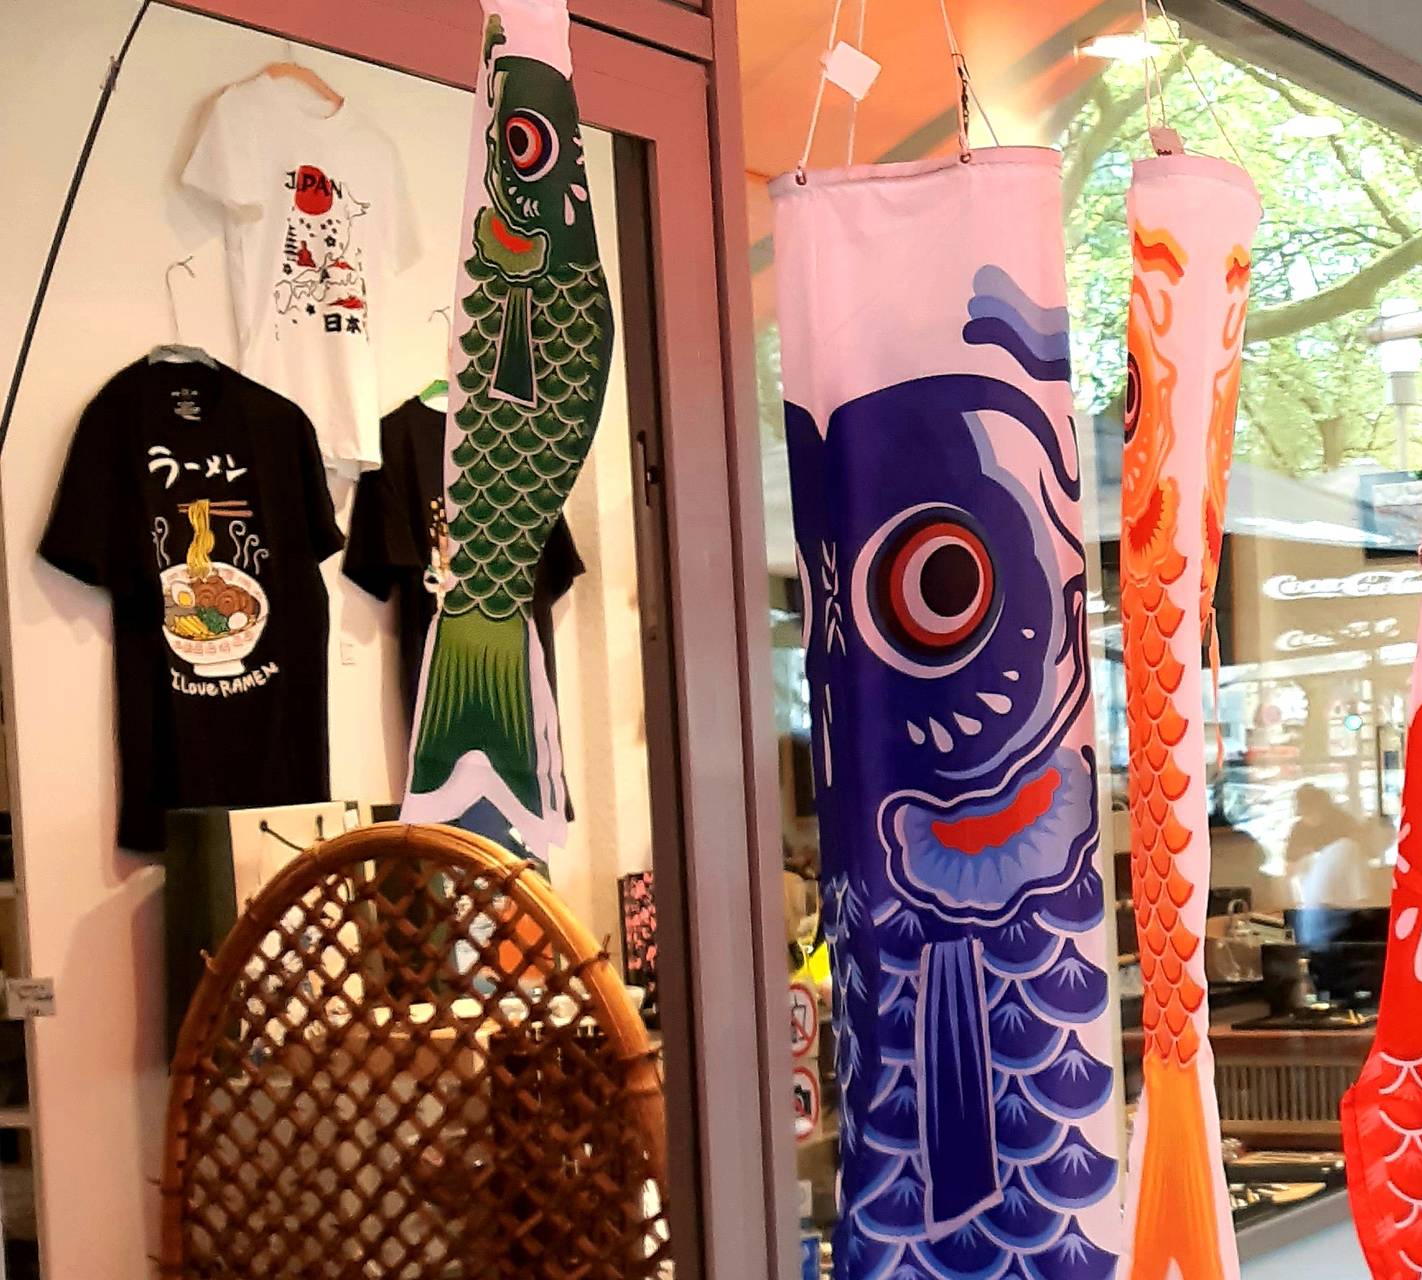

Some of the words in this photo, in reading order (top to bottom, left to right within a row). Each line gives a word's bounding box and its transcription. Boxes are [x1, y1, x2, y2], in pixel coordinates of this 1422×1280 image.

[323, 313, 361, 333] 日本
[147, 445, 248, 489] ラーメン
[218, 661, 280, 698] RAMEN
